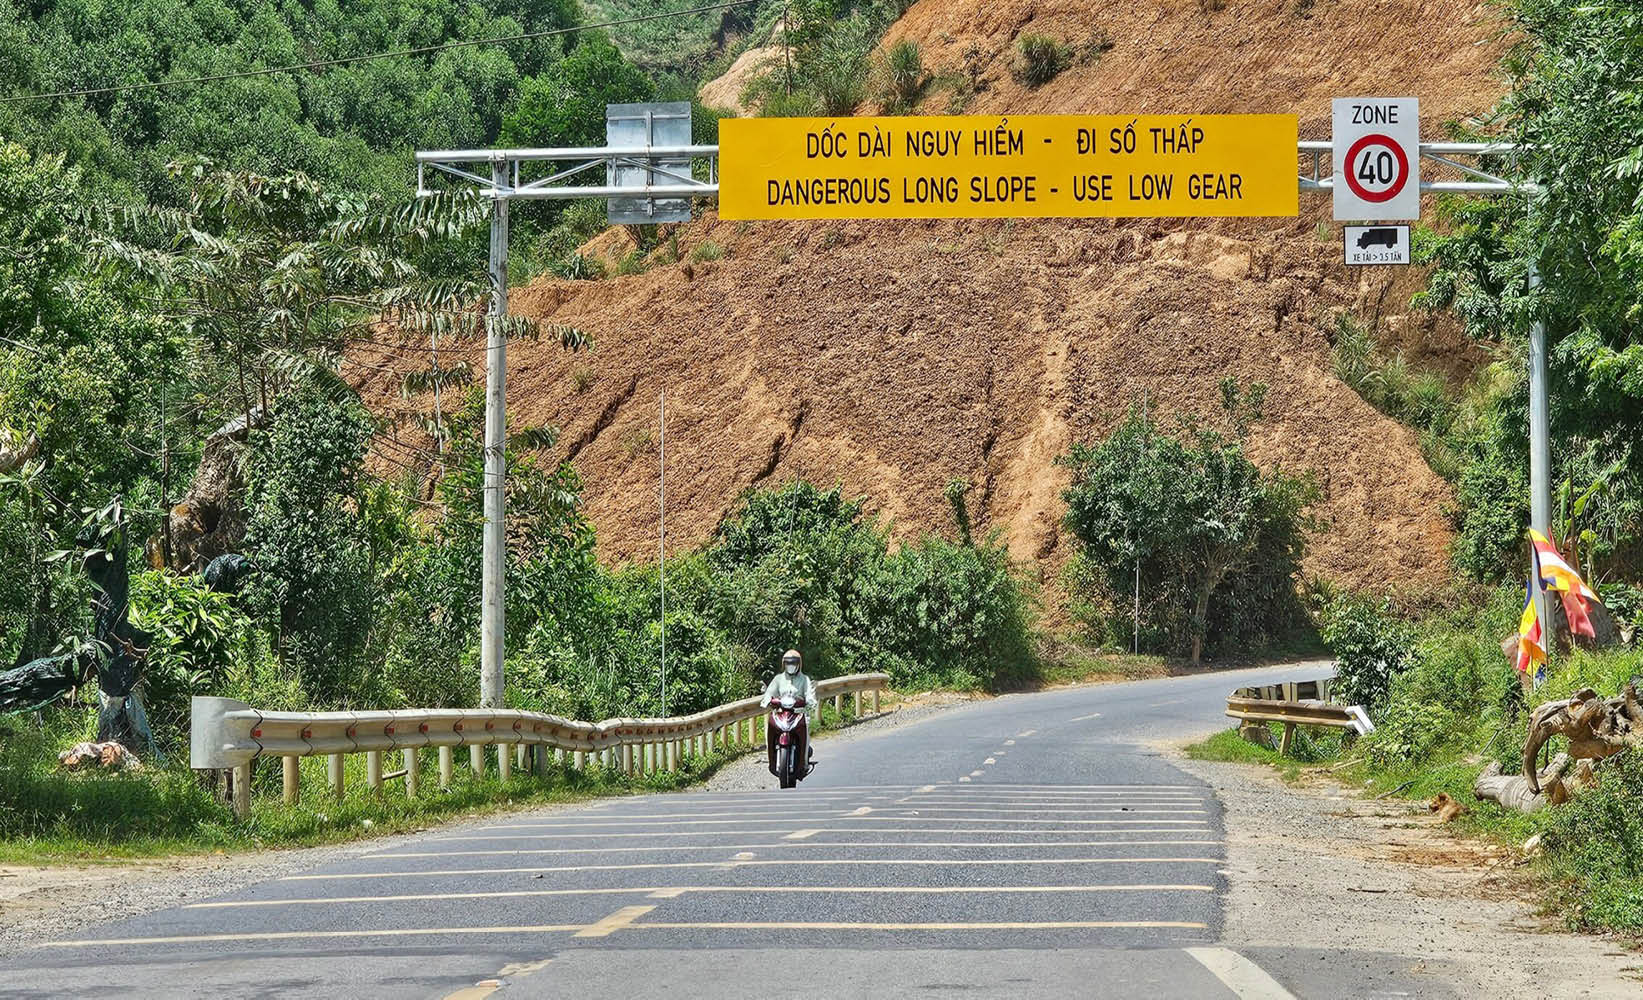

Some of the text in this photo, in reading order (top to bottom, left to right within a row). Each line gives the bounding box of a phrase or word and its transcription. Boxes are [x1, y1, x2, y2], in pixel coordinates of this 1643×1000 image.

[1352, 105, 1398, 124] ZONE
[806, 122, 847, 159] DỐC
[858, 125, 892, 158] DÀI
[906, 130, 962, 156] NGUY
[974, 118, 1024, 156] HIỂM
[1077, 128, 1096, 154] ĐI
[1109, 119, 1137, 154] SỐ
[1149, 119, 1204, 154] THẤP
[1358, 151, 1393, 184] 40
[767, 178, 890, 206] DANGEROUS
[903, 177, 959, 203] LONG
[970, 176, 1037, 203] SLOPE
[1073, 175, 1113, 202] USE
[1129, 174, 1173, 200] LOW
[1188, 173, 1243, 200] GEAR
[1353, 253, 1361, 262] XE
